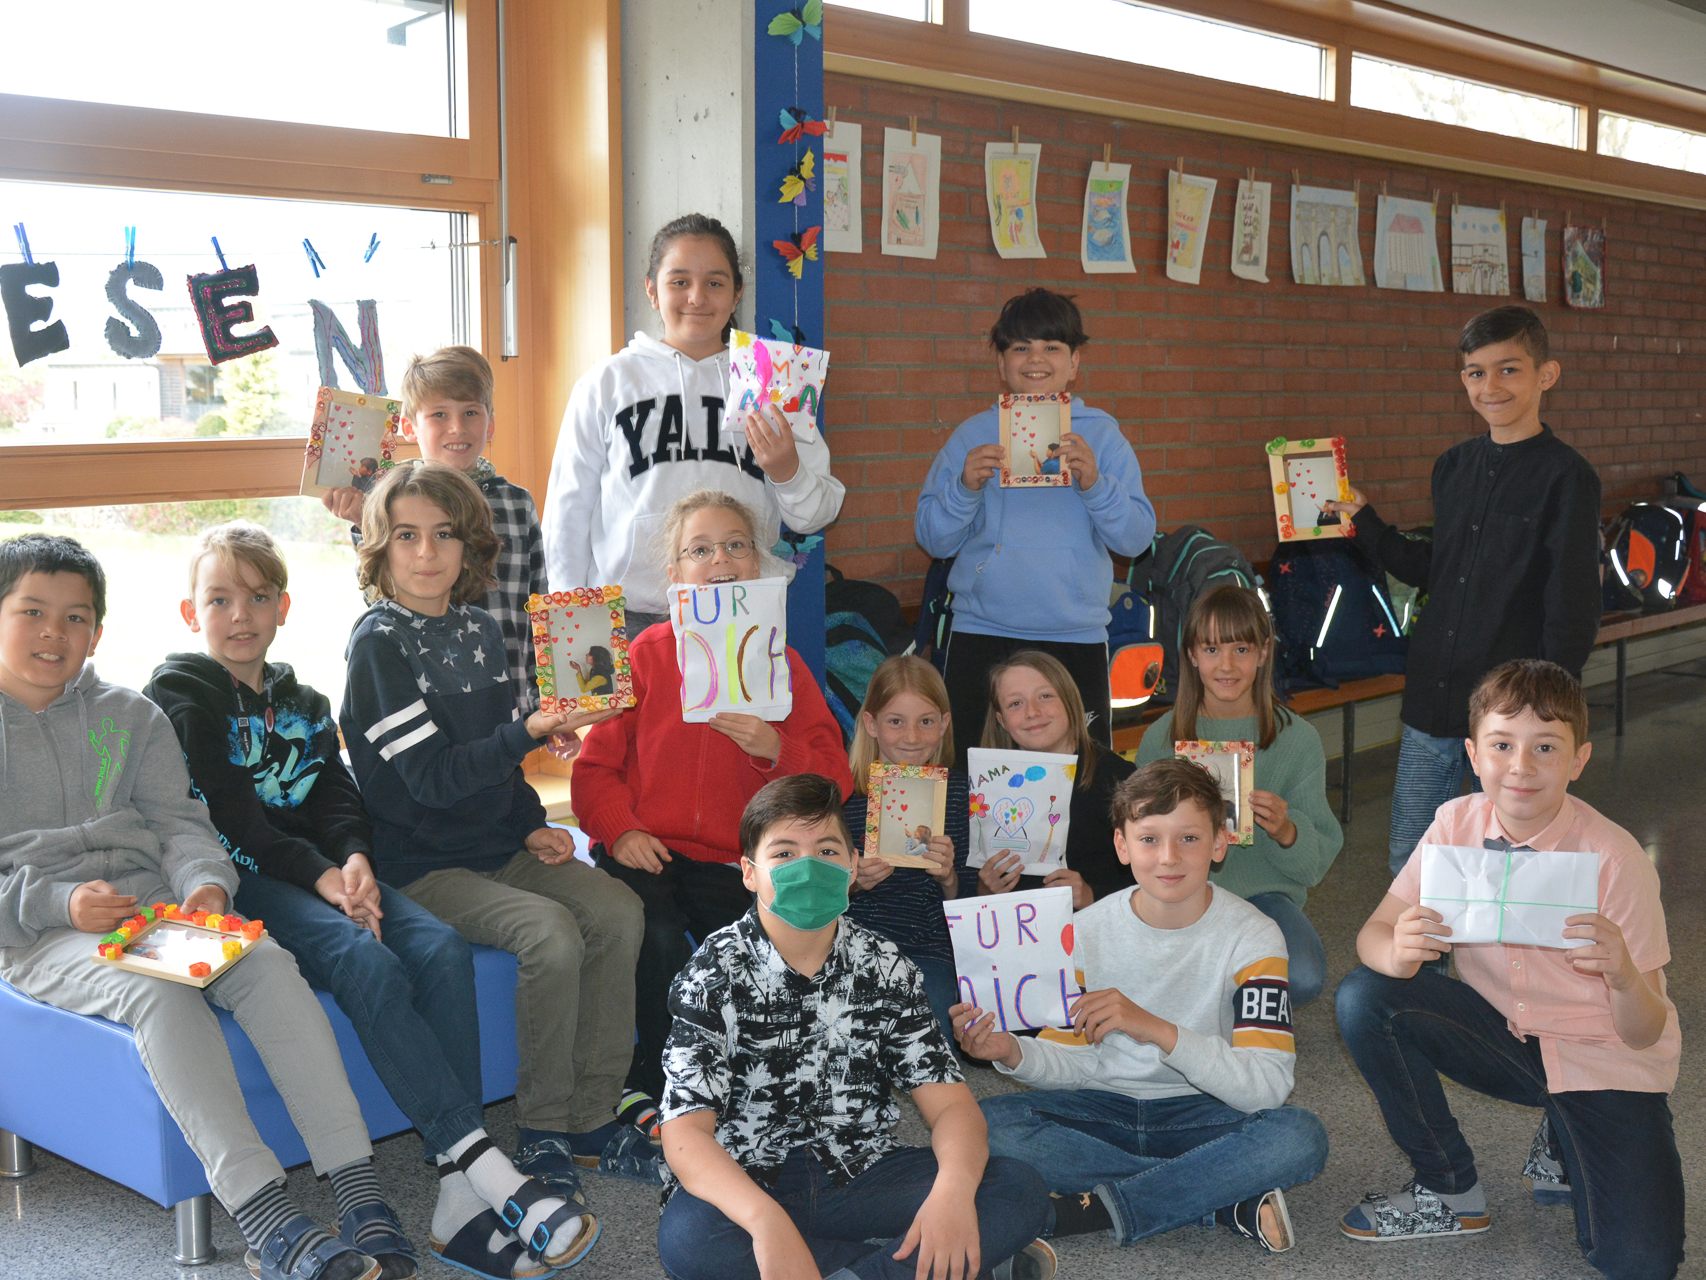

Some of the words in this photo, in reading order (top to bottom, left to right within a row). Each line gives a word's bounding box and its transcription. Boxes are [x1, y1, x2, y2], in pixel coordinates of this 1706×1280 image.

[0, 258, 388, 397] ESEN
[677, 585, 750, 626] FÜR
[681, 623, 793, 712] DICH
[1241, 987, 1294, 1025] BEA
